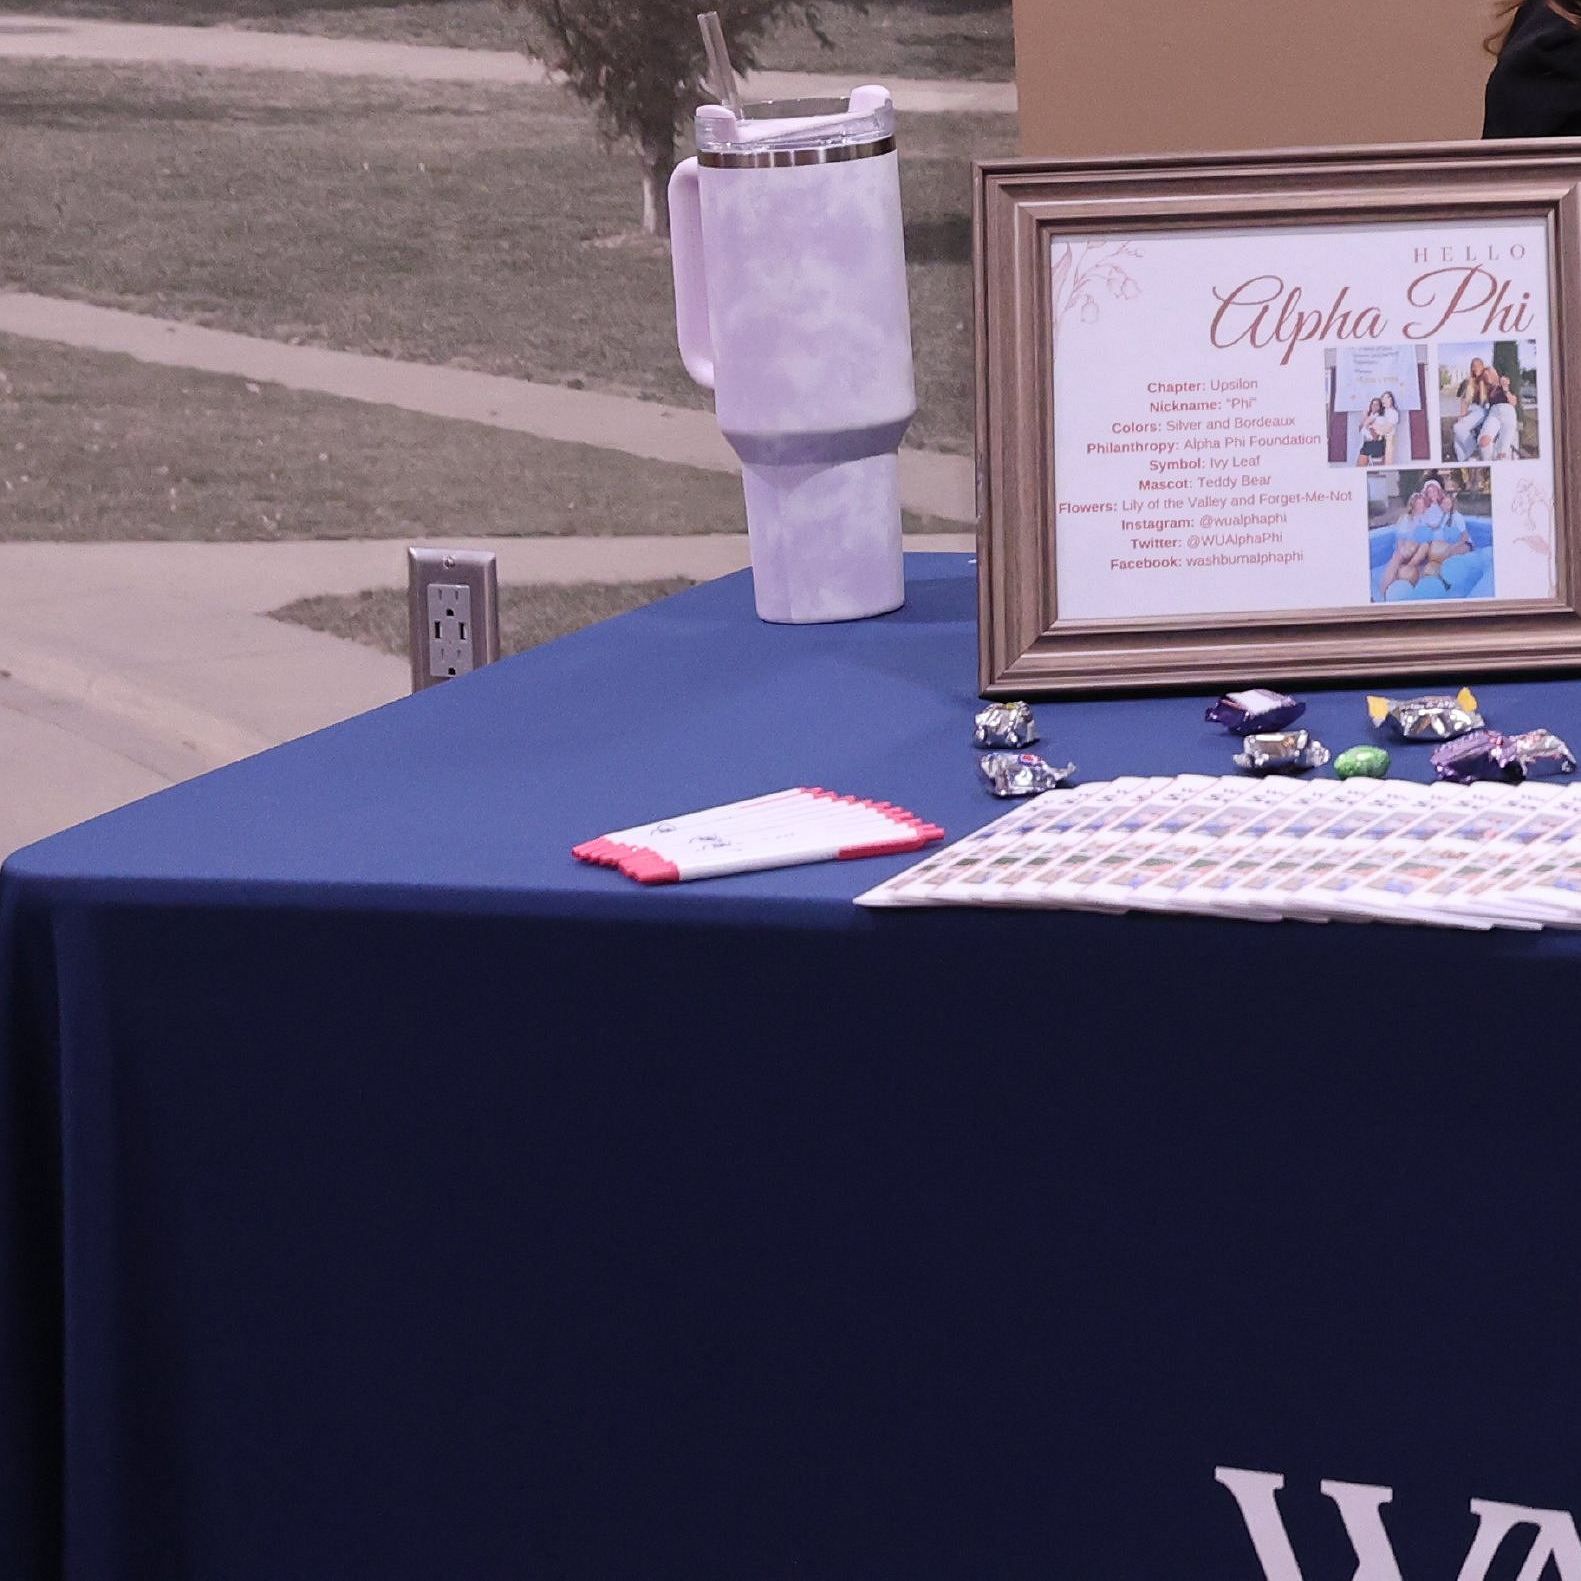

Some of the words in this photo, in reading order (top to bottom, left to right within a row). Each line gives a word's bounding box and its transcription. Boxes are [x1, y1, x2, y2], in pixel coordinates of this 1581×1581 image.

[1413, 244, 1526, 264] HELLO
[1210, 275, 1388, 365] Alpha
[1402, 265, 1535, 340] Phi
[1147, 382, 1206, 395] Chapter:
[1210, 378, 1258, 393] Upsilon
[1150, 400, 1222, 413] Nickname:
[1111, 421, 1161, 434] Colors:
[1166, 418, 1201, 431] Silver
[1206, 417, 1230, 430] and
[1235, 415, 1296, 429] Bordeaux
[1086, 440, 1180, 454] Philanthropy:
[1184, 438, 1220, 451] Alpha
[1224, 435, 1245, 448] Phi
[1249, 433, 1321, 447] Foundation
[1149, 457, 1206, 474] Symbol:
[1210, 455, 1229, 470] Ivy
[1233, 454, 1260, 467] Leaf
[1138, 478, 1192, 491] Mascot:
[1197, 475, 1237, 490] Teddy
[1241, 473, 1272, 487] Bear
[1059, 501, 1118, 514] Flowers:
[1122, 498, 1144, 514] Lily
[1147, 498, 1161, 510] of
[1163, 497, 1184, 509] the
[1187, 494, 1228, 509] Valley
[1230, 493, 1256, 507] and
[1259, 490, 1353, 507] Forget-Me-Not
[1121, 518, 1195, 532] Instagram:
[1130, 538, 1182, 550] Twitter:
[1110, 557, 1182, 571] Facebook:
